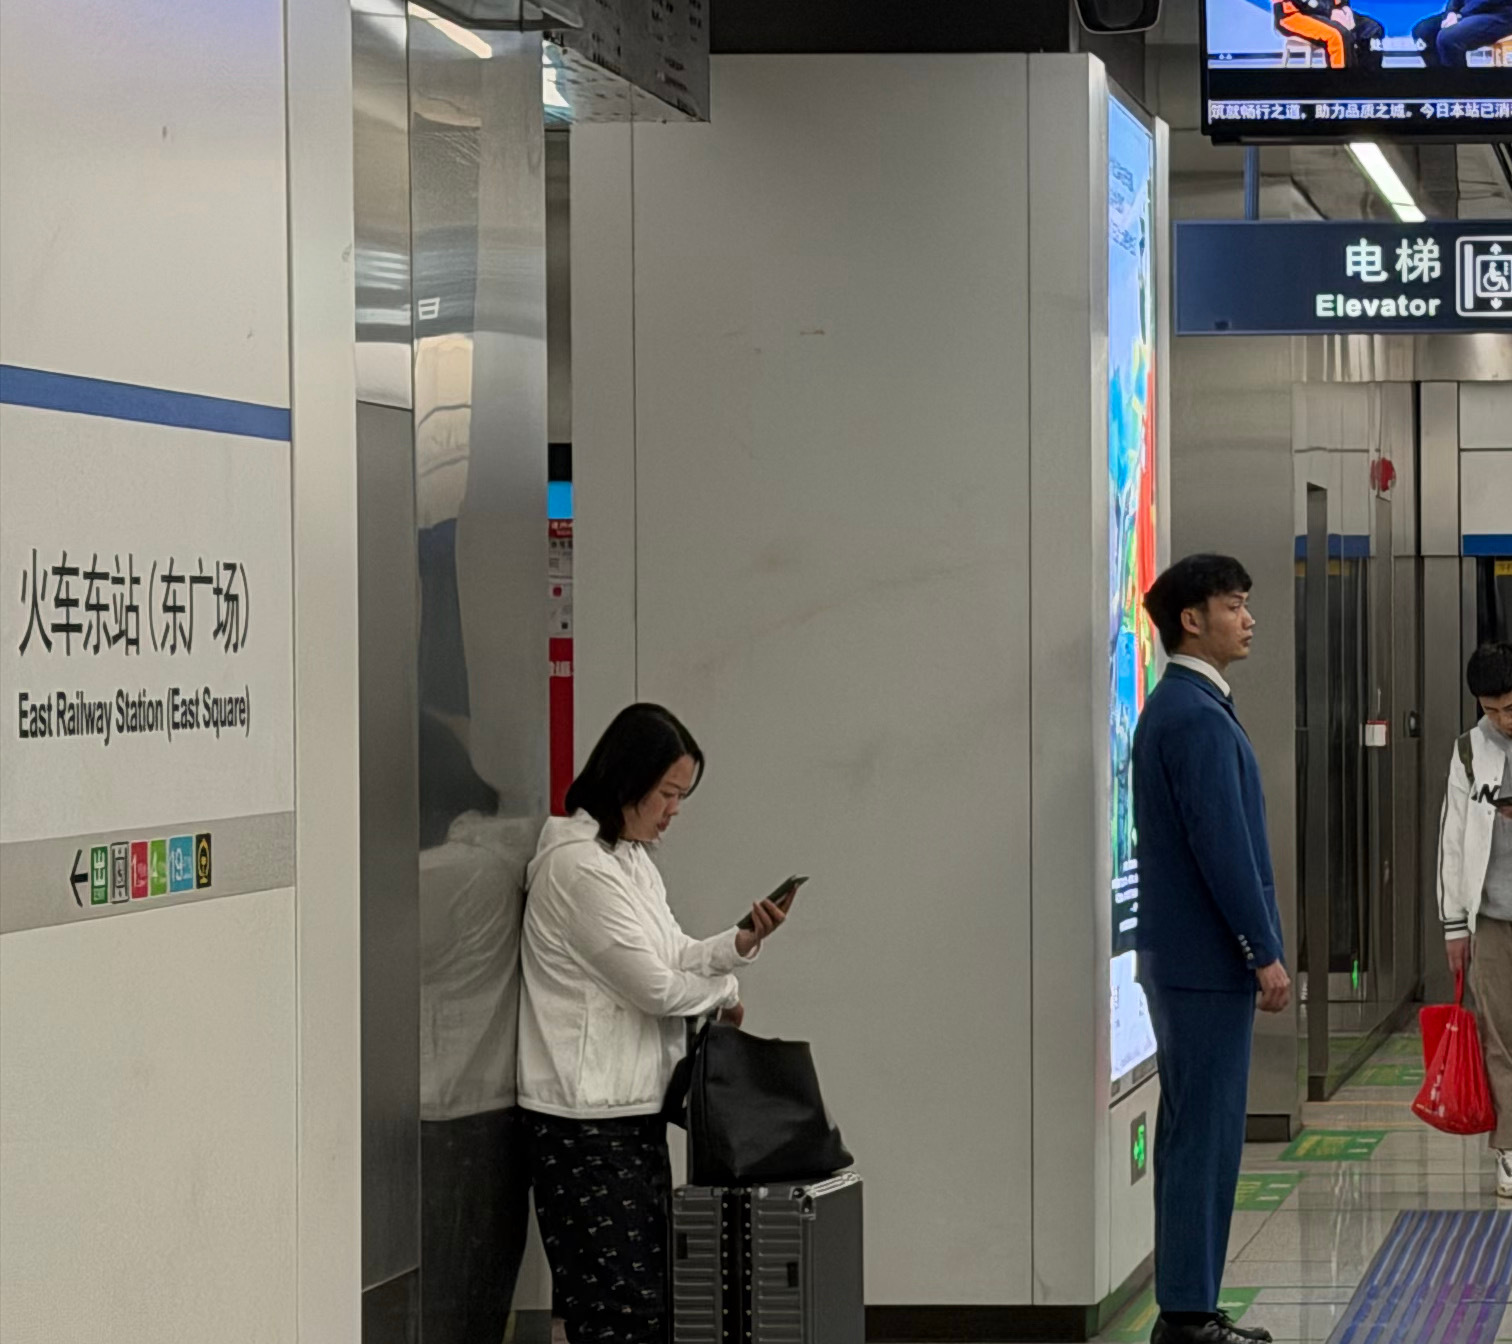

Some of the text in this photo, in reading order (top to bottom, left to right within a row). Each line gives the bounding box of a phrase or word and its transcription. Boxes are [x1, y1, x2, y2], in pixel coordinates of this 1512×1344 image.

[1345, 237, 1442, 284] 电梯
[1315, 295, 1442, 318] Elevator
[18, 548, 251, 657] 火车东站（东广场）
[18, 684, 251, 747] East Railway Station (East Square)
